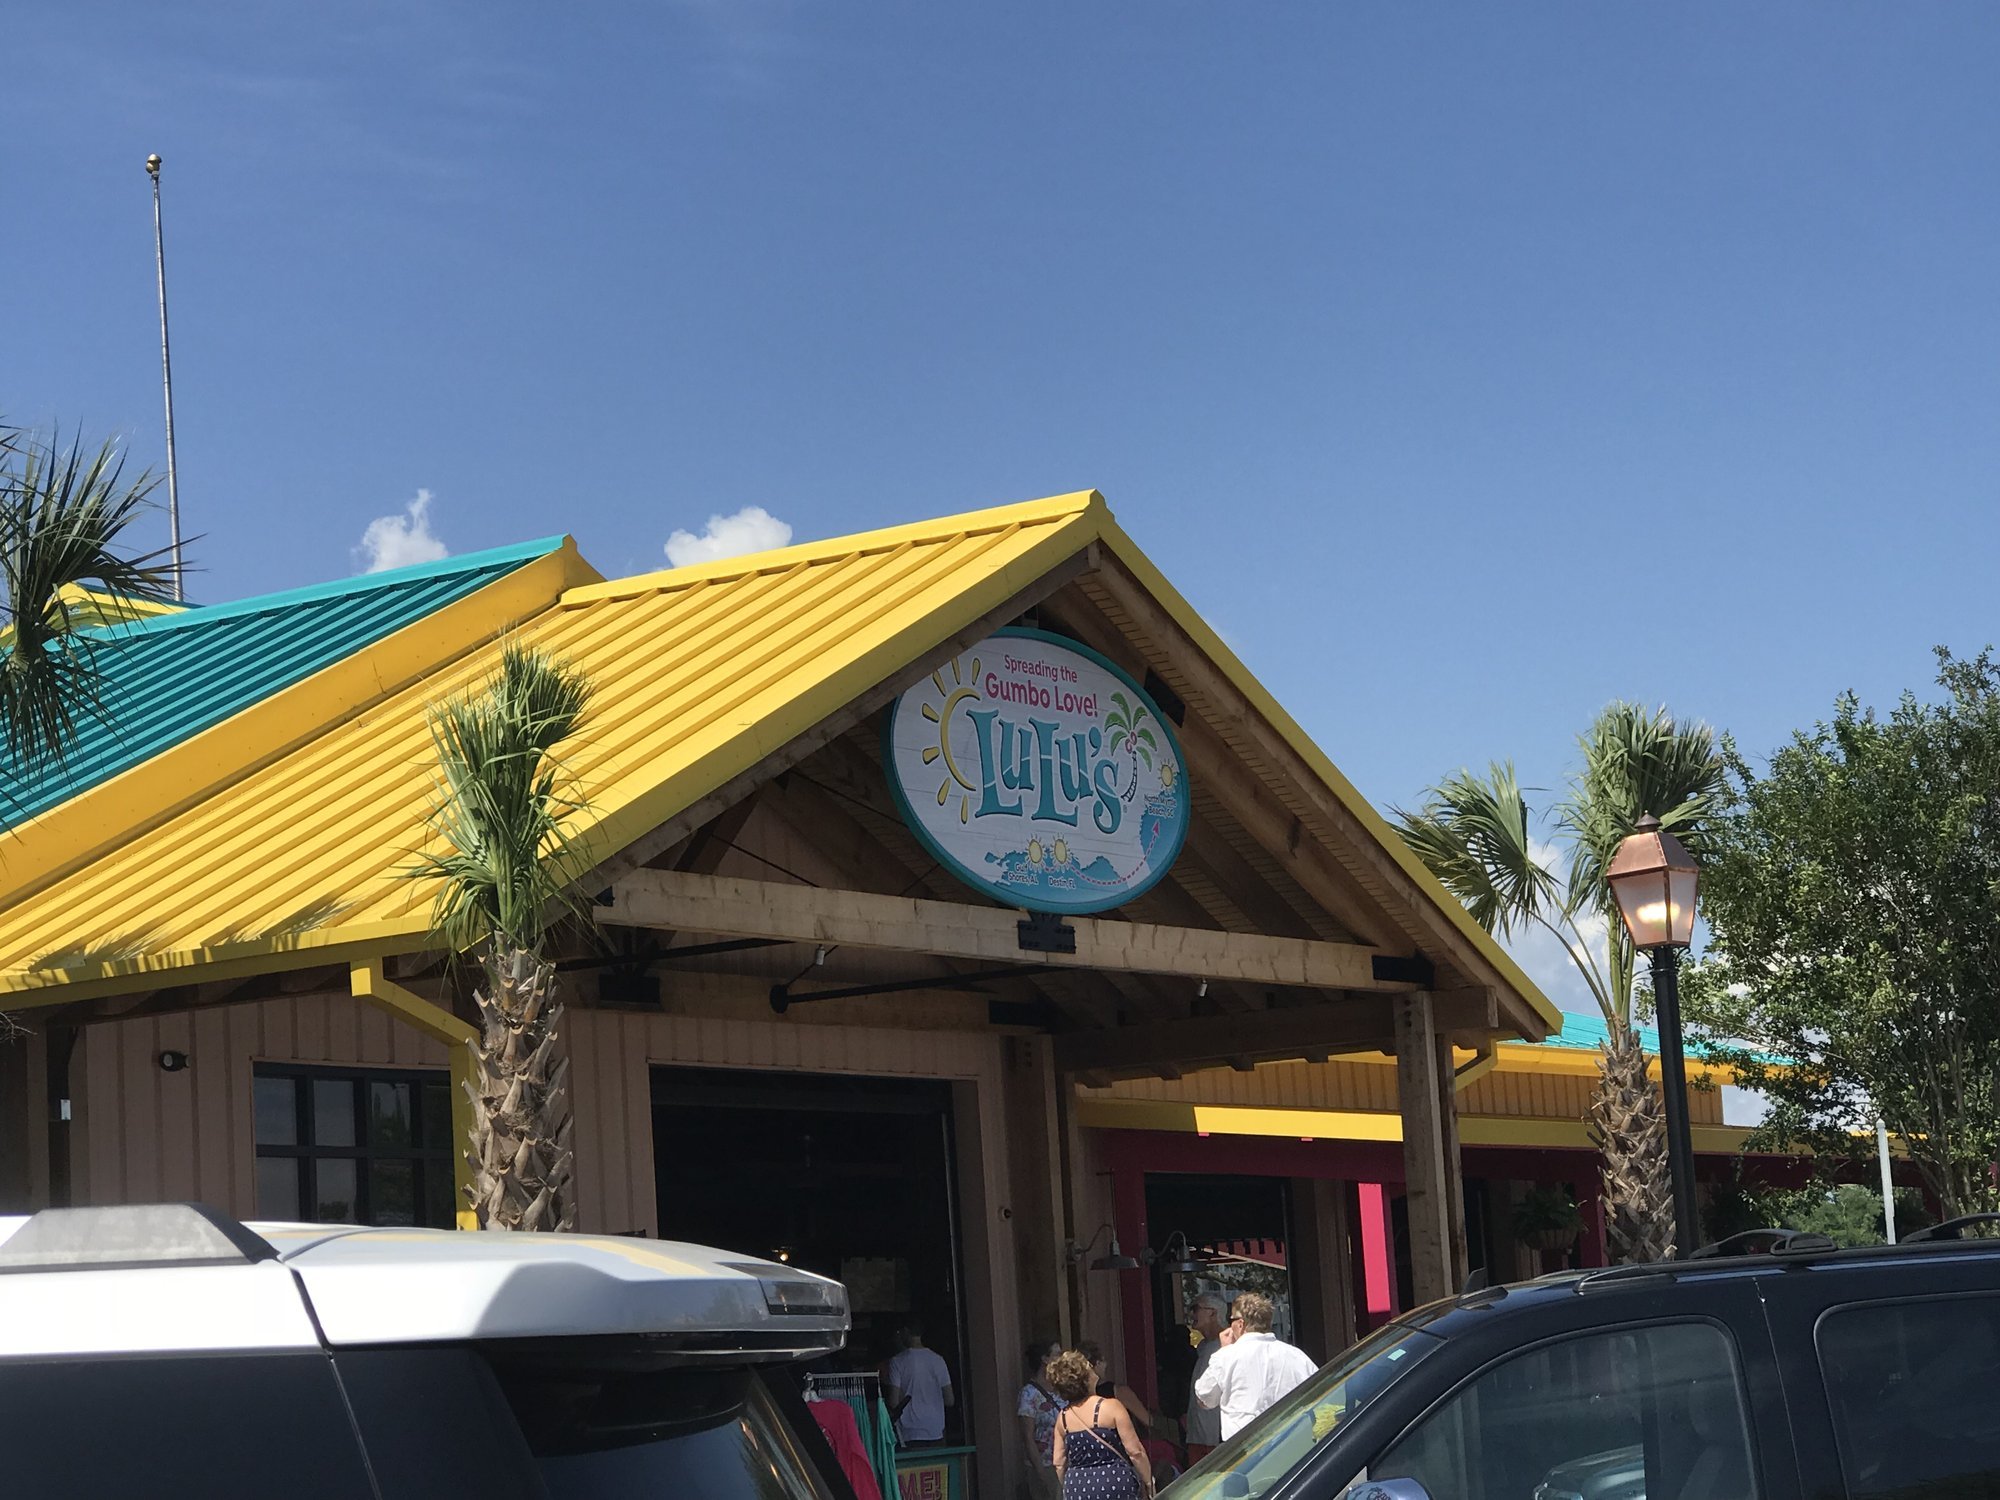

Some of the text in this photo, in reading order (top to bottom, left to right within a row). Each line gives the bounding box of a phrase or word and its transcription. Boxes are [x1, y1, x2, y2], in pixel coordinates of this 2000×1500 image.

[1004, 654, 1078, 683] Spreading the
[985, 672, 1098, 718] Gumbo Love!
